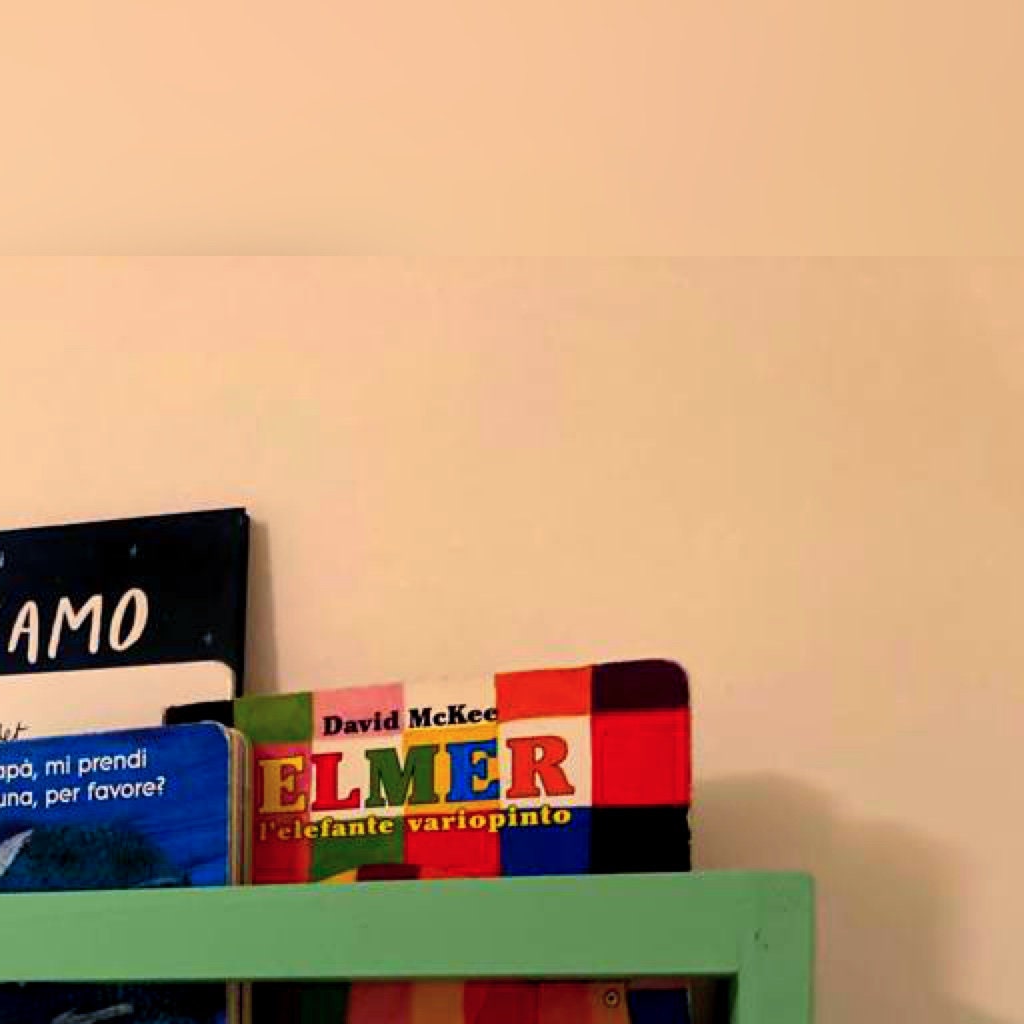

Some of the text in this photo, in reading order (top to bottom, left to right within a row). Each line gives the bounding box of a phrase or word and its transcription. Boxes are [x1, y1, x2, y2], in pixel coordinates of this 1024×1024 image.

[322, 703, 498, 737] David McKee
[45, 754, 71, 776] mi
[77, 747, 147, 777] prendi
[258, 734, 575, 814] ELMER
[45, 787, 81, 809] per
[87, 775, 167, 801] favore?
[260, 806, 572, 841] l'elefante variopinto
